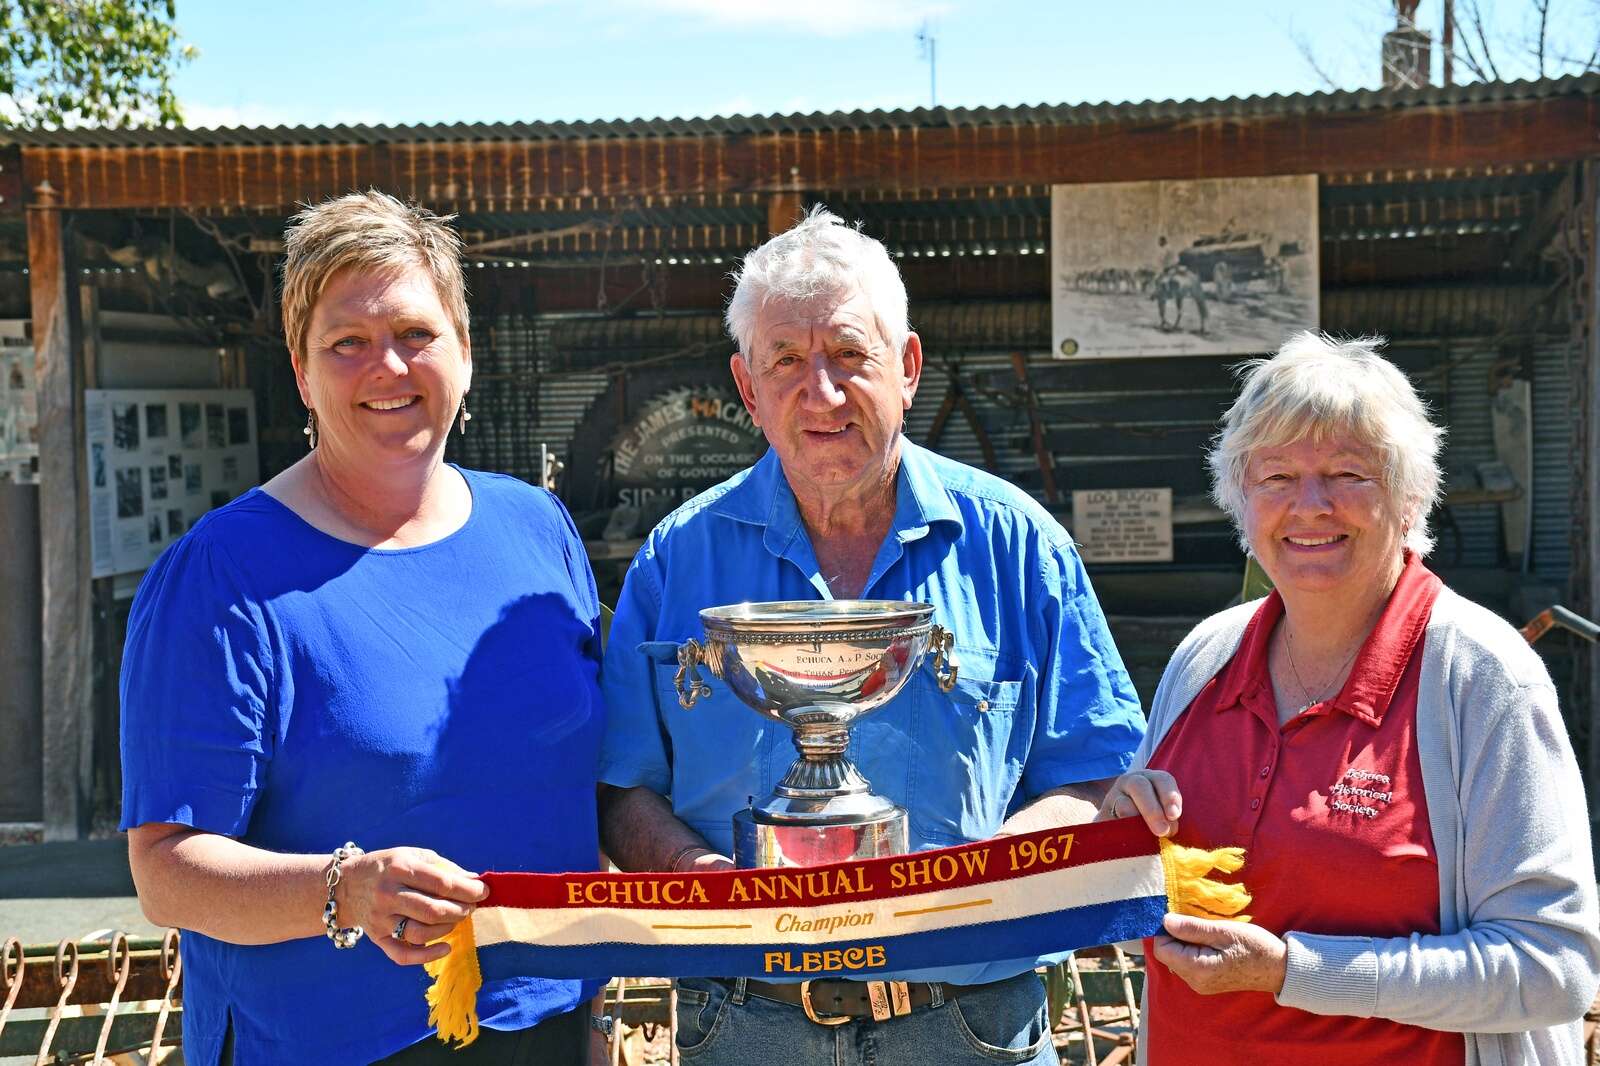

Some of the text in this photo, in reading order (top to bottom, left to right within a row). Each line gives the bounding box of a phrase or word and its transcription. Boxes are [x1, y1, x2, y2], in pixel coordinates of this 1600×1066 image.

[614, 439, 639, 474] THE
[637, 401, 686, 446] JAMES
[661, 425, 739, 446] PRESENTED
[643, 454, 665, 465] ON
[669, 454, 694, 465] THE
[657, 467, 676, 479] OF
[1086, 492, 1113, 504] LOG
[838, 653, 845, 662] A
[855, 653, 862, 662] P
[1332, 784, 1392, 802] Historical
[1333, 800, 1378, 817] Society
[566, 833, 1076, 905] ECHUCA ANNUAL SHOW 1967
[775, 909, 875, 935] Champion
[764, 945, 887, 972] FLEECE
